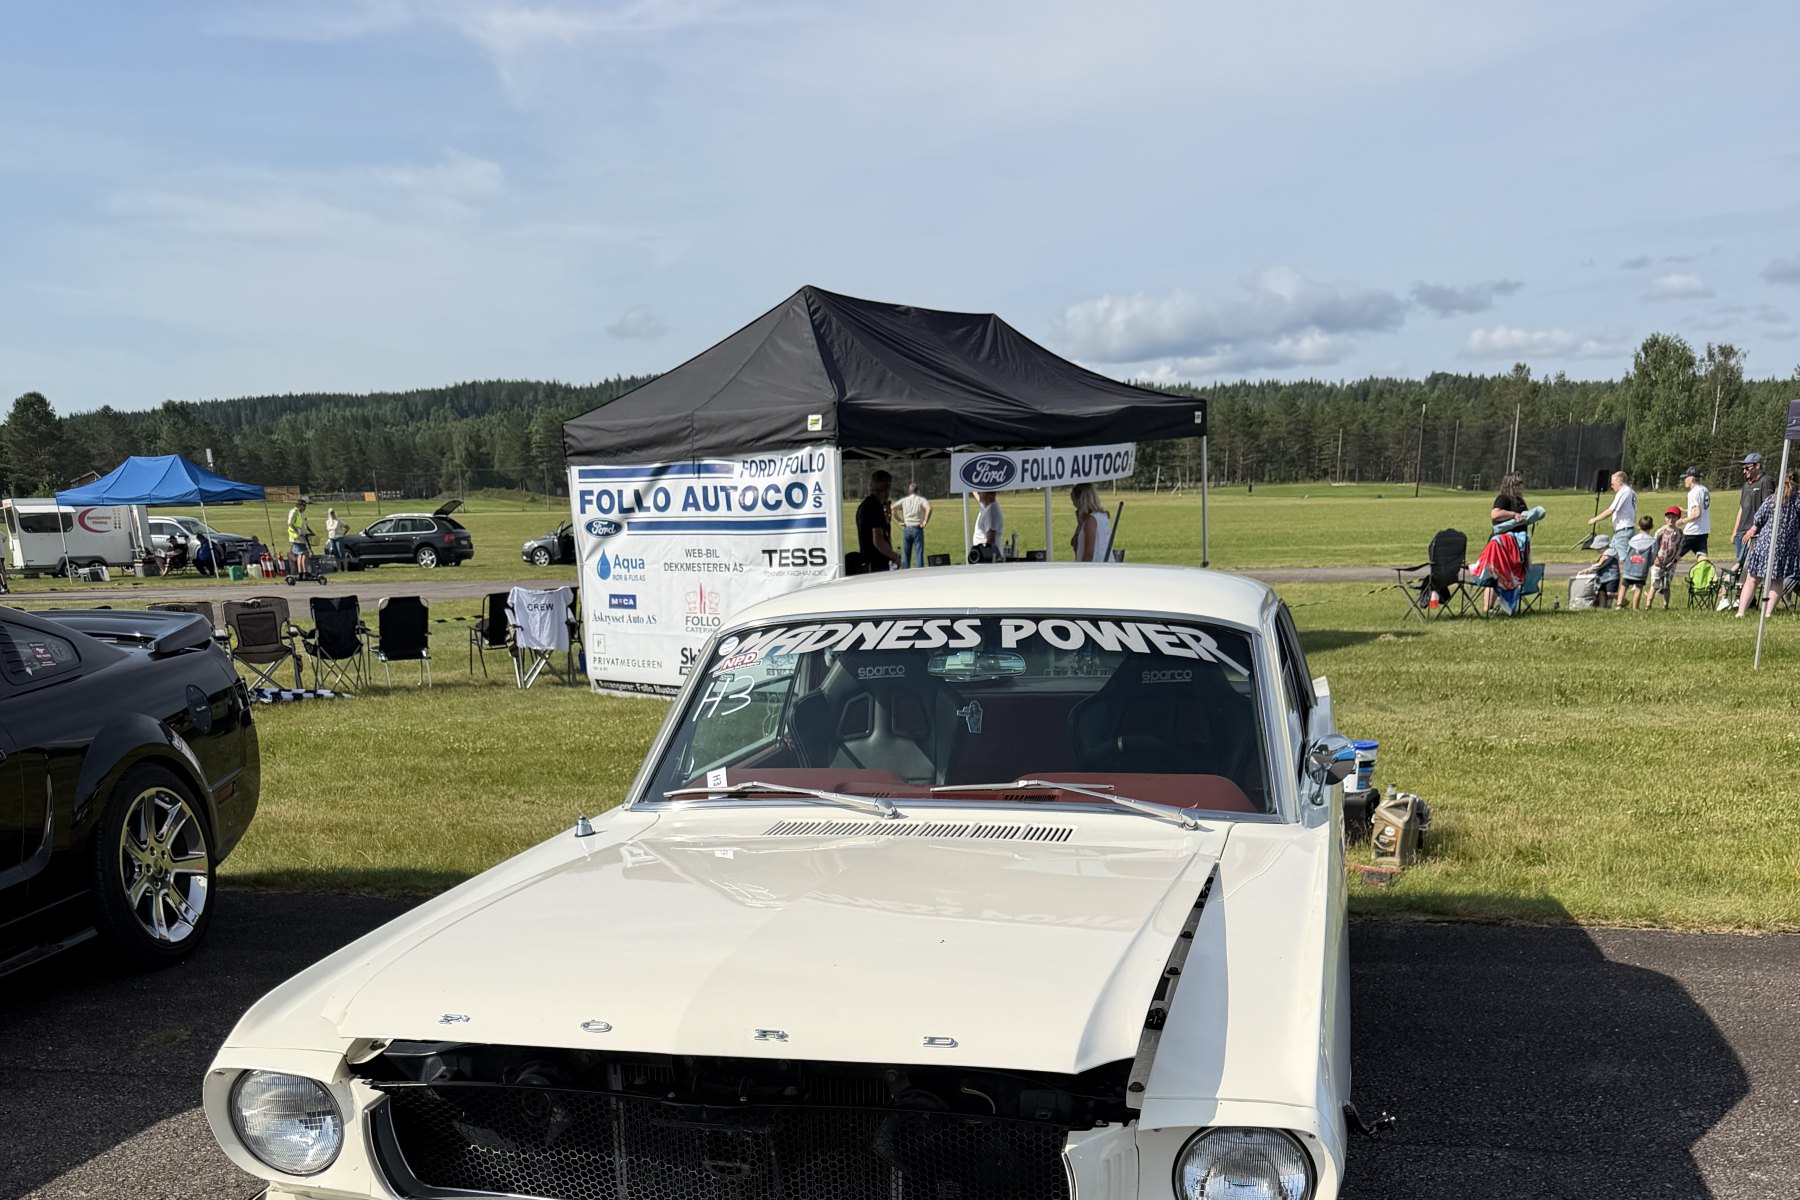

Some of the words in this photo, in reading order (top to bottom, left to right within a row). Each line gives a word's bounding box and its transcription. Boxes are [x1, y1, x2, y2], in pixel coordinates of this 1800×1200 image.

[740, 459, 777, 478] FORD
[783, 453, 825, 475] FOLLO
[972, 460, 1007, 483] Ford
[1021, 456, 1065, 483] FOLLO
[1070, 450, 1129, 478] AUTOCO
[579, 487, 671, 515] FOLLO
[681, 482, 808, 512] AUTOCO
[591, 521, 616, 534] Ford
[685, 549, 720, 558] WEB-BIL
[762, 548, 827, 568] TESS
[613, 554, 645, 573] Aqua
[663, 562, 730, 572] DEKKMESTEREN
[527, 603, 553, 612] CREW
[626, 614, 644, 624] Auto
[646, 615, 657, 625] AS
[685, 616, 720, 627] FOLLO
[685, 626, 716, 634] CATERIN
[708, 619, 982, 673] MADNESS
[1000, 619, 1250, 677] POWER
[593, 657, 662, 669] PRIVATMEGLEREN
[681, 647, 701, 666] Sk
[858, 664, 905, 679] sparco
[1141, 669, 1192, 684] sparco
[693, 676, 755, 721] H3
[712, 774, 722, 787] H3
